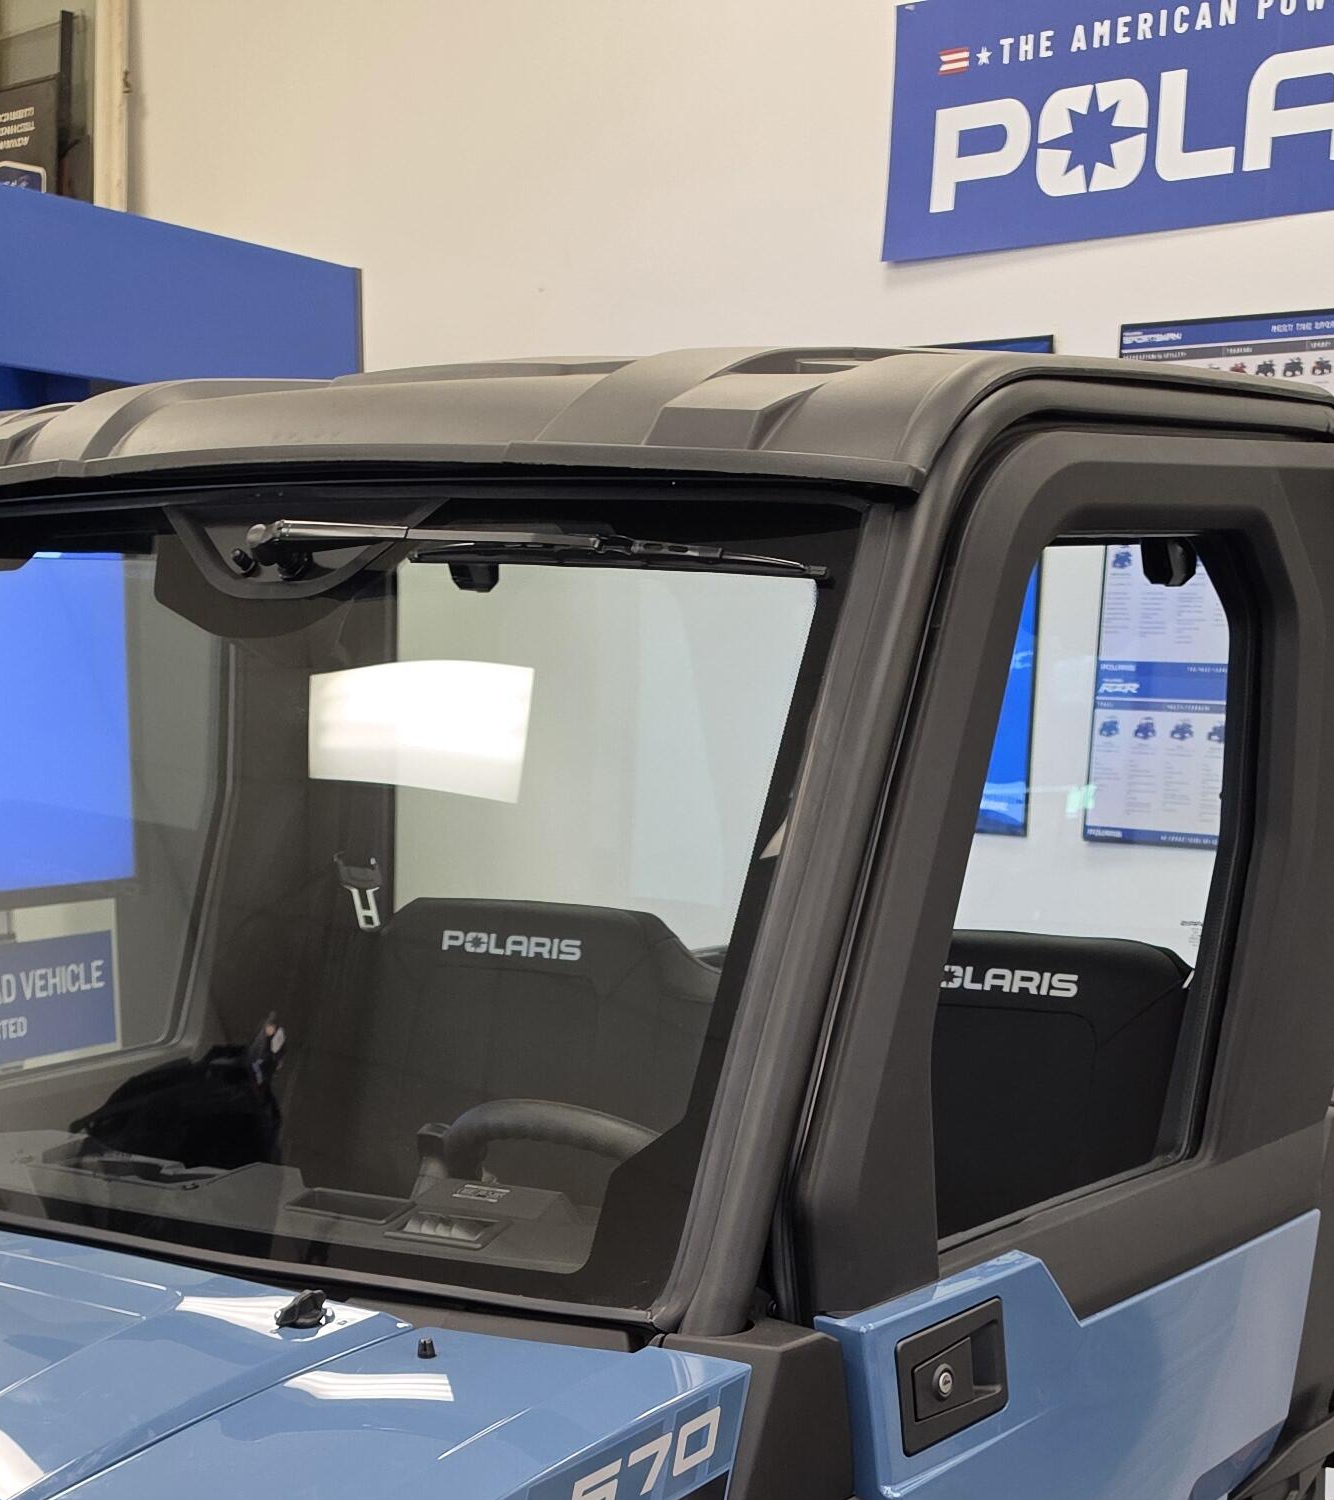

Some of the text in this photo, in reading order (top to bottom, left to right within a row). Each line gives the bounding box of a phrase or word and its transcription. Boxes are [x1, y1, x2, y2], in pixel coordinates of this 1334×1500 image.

[999, 30, 1056, 65] THE
[1070, 0, 1238, 53] AMERICAN
[441, 930, 582, 961] POLARIS
[19, 959, 105, 997] VEHICLE
[940, 964, 1079, 998] OLARIS
